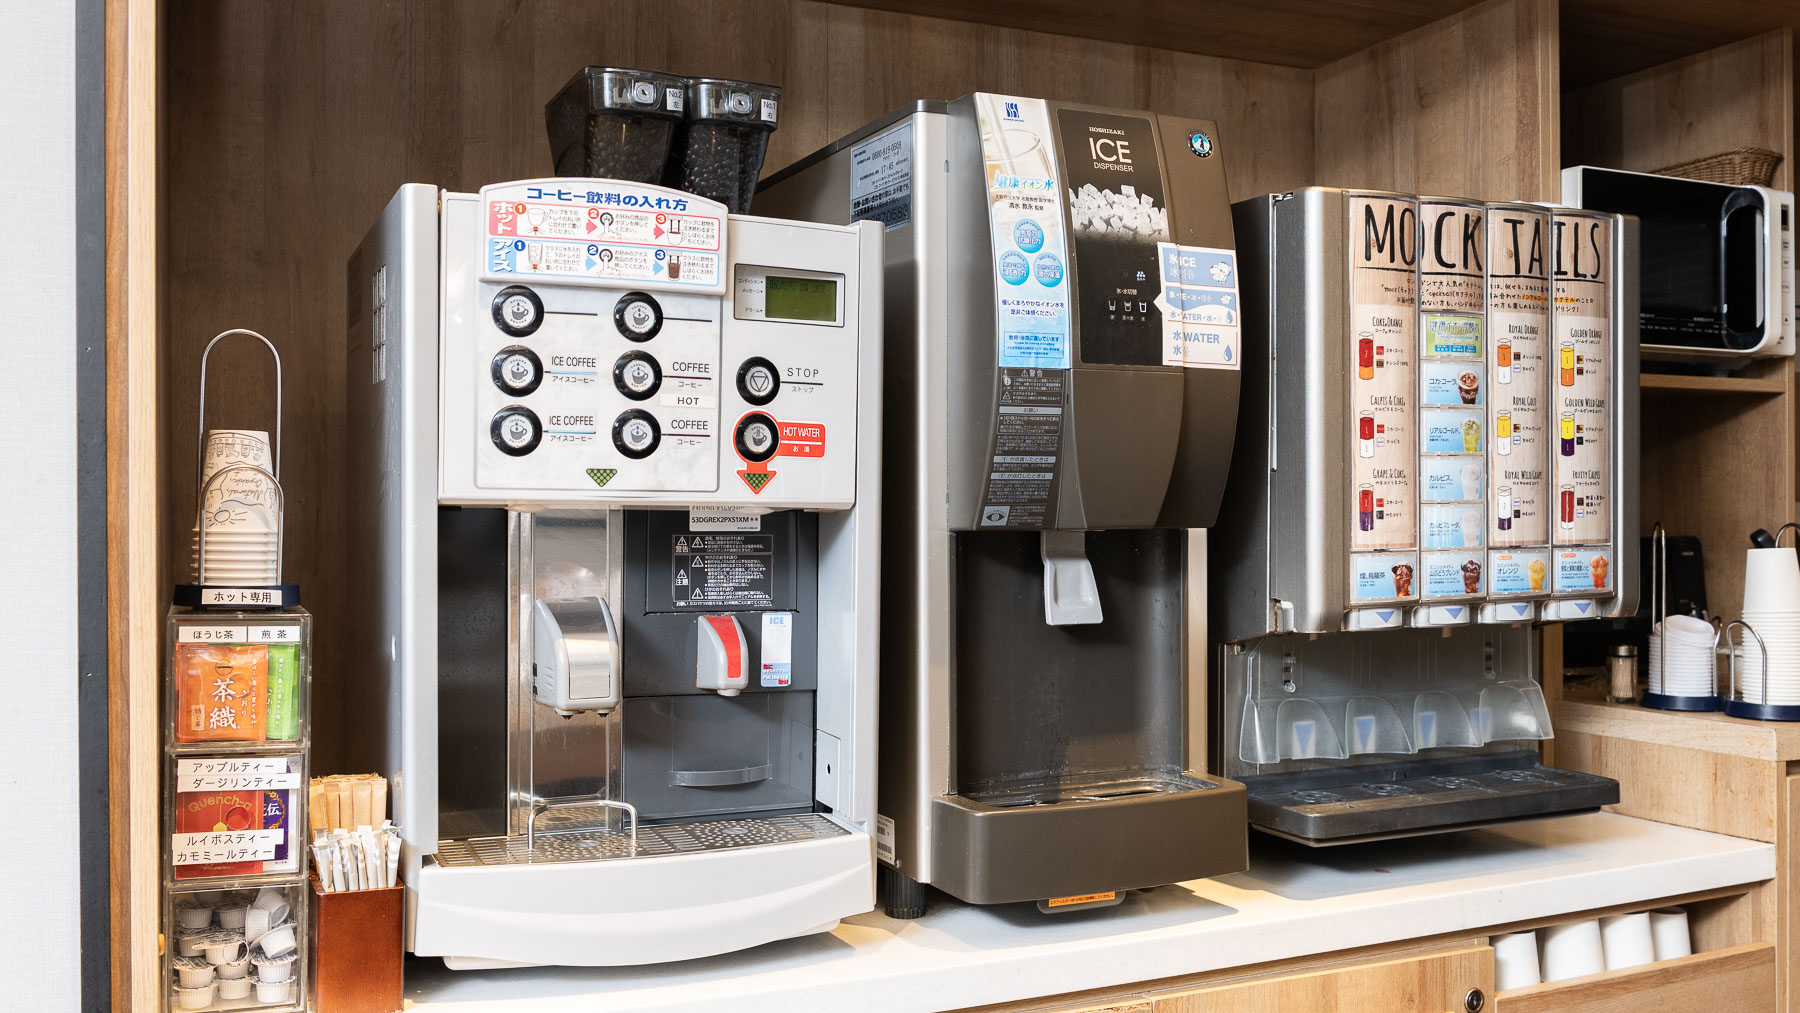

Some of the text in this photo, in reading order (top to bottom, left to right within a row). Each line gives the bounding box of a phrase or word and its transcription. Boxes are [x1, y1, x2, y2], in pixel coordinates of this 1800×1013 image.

[668, 89, 682, 99] No.2
[763, 101, 776, 110] No.1
[1088, 126, 1125, 136] HOSHIZAKI
[1088, 137, 1132, 164] ICE
[1093, 161, 1134, 173] DISPENSER
[527, 187, 689, 212] コーヒー飲料の入れ方
[493, 201, 514, 235] ホット
[493, 238, 513, 273] アイス
[1168, 253, 1197, 268] 氷 ICE
[1508, 324, 1539, 336] ROYAL ORANGE
[1570, 327, 1603, 339] GOLDEN ORANGE
[1172, 330, 1220, 344] 水 WATER
[1172, 344, 1182, 356] 水
[551, 355, 597, 368] ICE COFFEE
[672, 361, 710, 373] COFFEE
[787, 367, 819, 378] STOP
[1029, 369, 1043, 378] 警告
[552, 375, 596, 384] アイスコーヒー
[678, 381, 703, 389] コーヒー
[677, 397, 700, 406] HOT
[1370, 395, 1387, 406] CALPIS
[1512, 395, 1526, 406] ROYAL
[1564, 397, 1584, 408] GOLDEN
[549, 415, 594, 426] ICE COFFEE
[670, 419, 708, 431] COFFEE
[783, 426, 820, 438] HOT WATER
[550, 435, 593, 443] アイスコーヒー
[676, 438, 702, 446] コーヒー
[1372, 468, 1388, 479] GRAPE
[1504, 469, 1520, 480] ROYAL
[1521, 470, 1532, 480] WILD
[1572, 469, 1601, 480] FRUITY CALPIS
[675, 545, 689, 553] 警告
[1497, 567, 1519, 575] オレンジ
[675, 578, 689, 586] 注意
[213, 591, 272, 604] ホット専用
[769, 616, 785, 625] ICE
[193, 630, 234, 640] ほうじ茶
[209, 678, 237, 729] 茶織
[192, 762, 274, 773] アップルティー
[192, 777, 287, 789] ダージリンティー
[186, 834, 270, 847] ルイボスティー
[177, 849, 273, 863] カモミールティー
